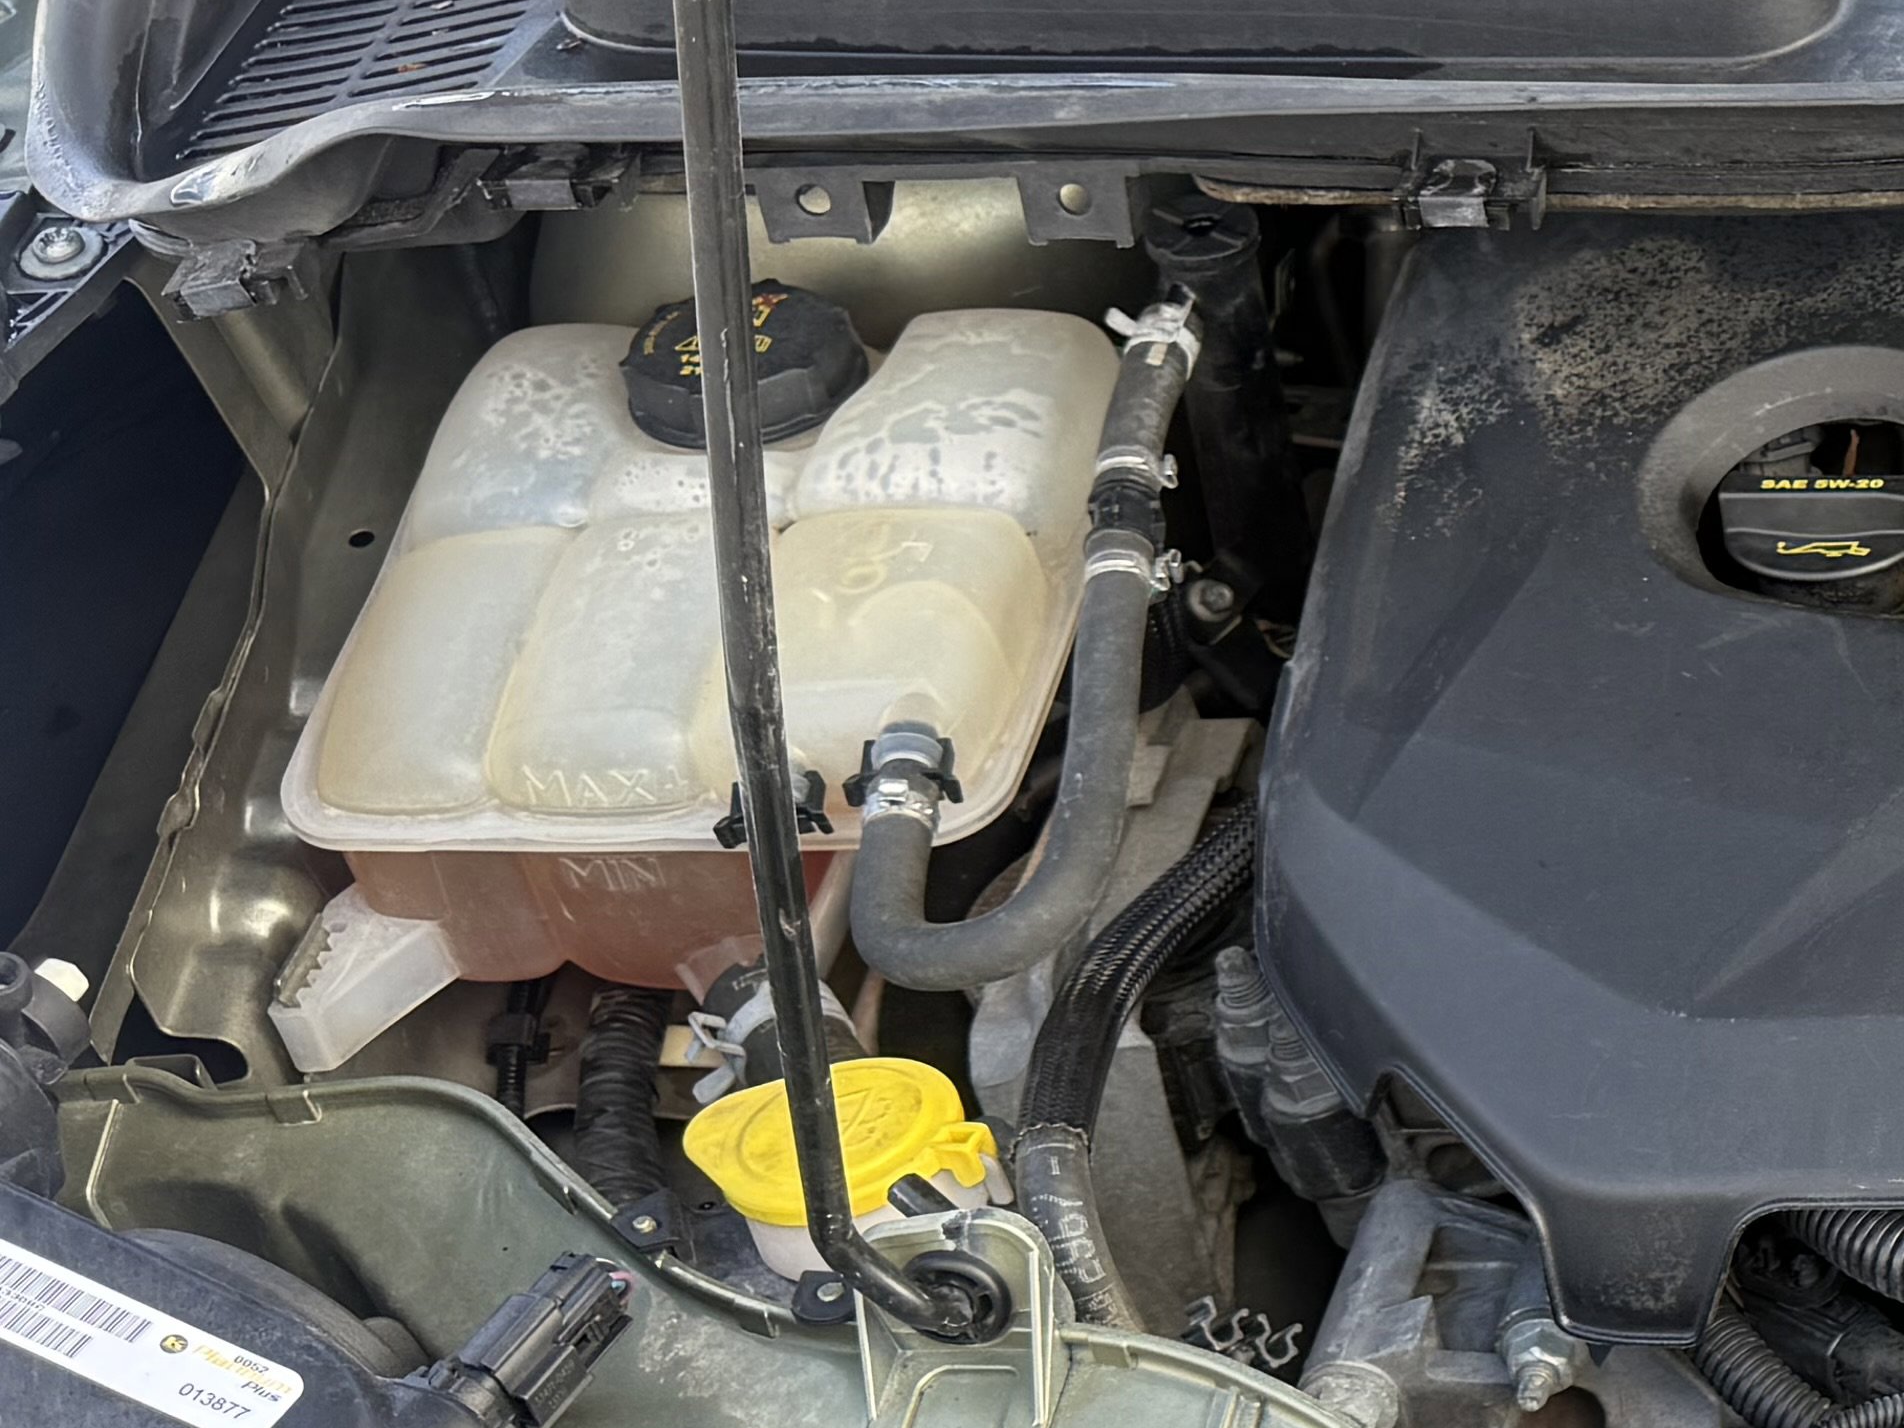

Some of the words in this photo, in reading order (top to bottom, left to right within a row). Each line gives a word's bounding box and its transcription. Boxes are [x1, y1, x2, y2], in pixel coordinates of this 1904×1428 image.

[1760, 479, 1808, 490] SAE
[1814, 478, 1885, 490] 5W-20
[521, 763, 657, 807] MAX
[559, 858, 668, 892] MIN
[234, 1355, 269, 1373] 0052
[179, 1383, 251, 1419] 013877
[241, 1381, 282, 1402] Plus
